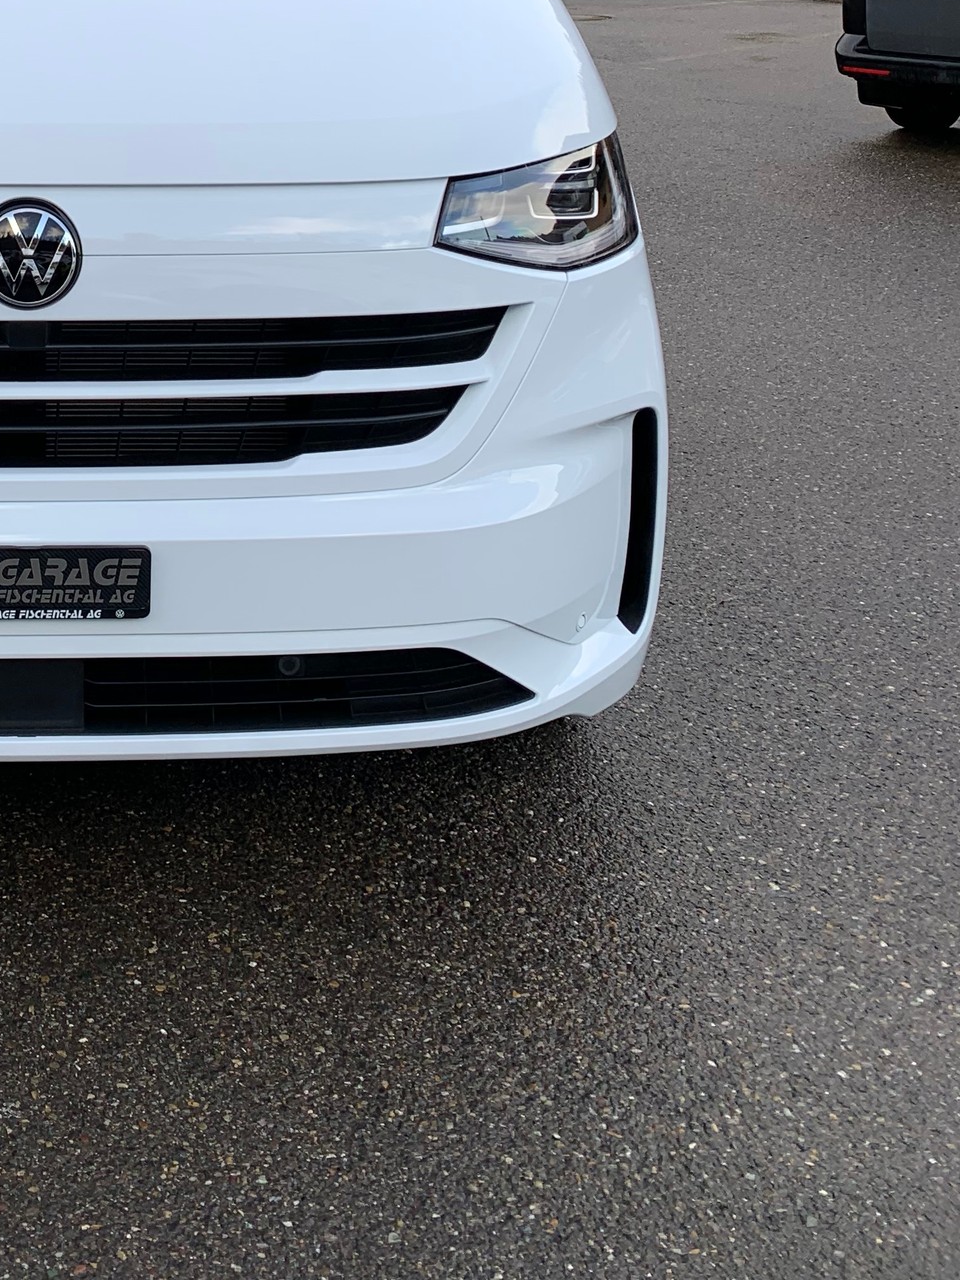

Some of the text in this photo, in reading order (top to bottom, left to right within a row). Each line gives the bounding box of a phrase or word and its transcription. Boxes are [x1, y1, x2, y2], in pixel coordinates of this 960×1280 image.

[108, 589, 136, 604] AG
[18, 609, 84, 619] FISCHENTHAL
[86, 609, 102, 619] AG
